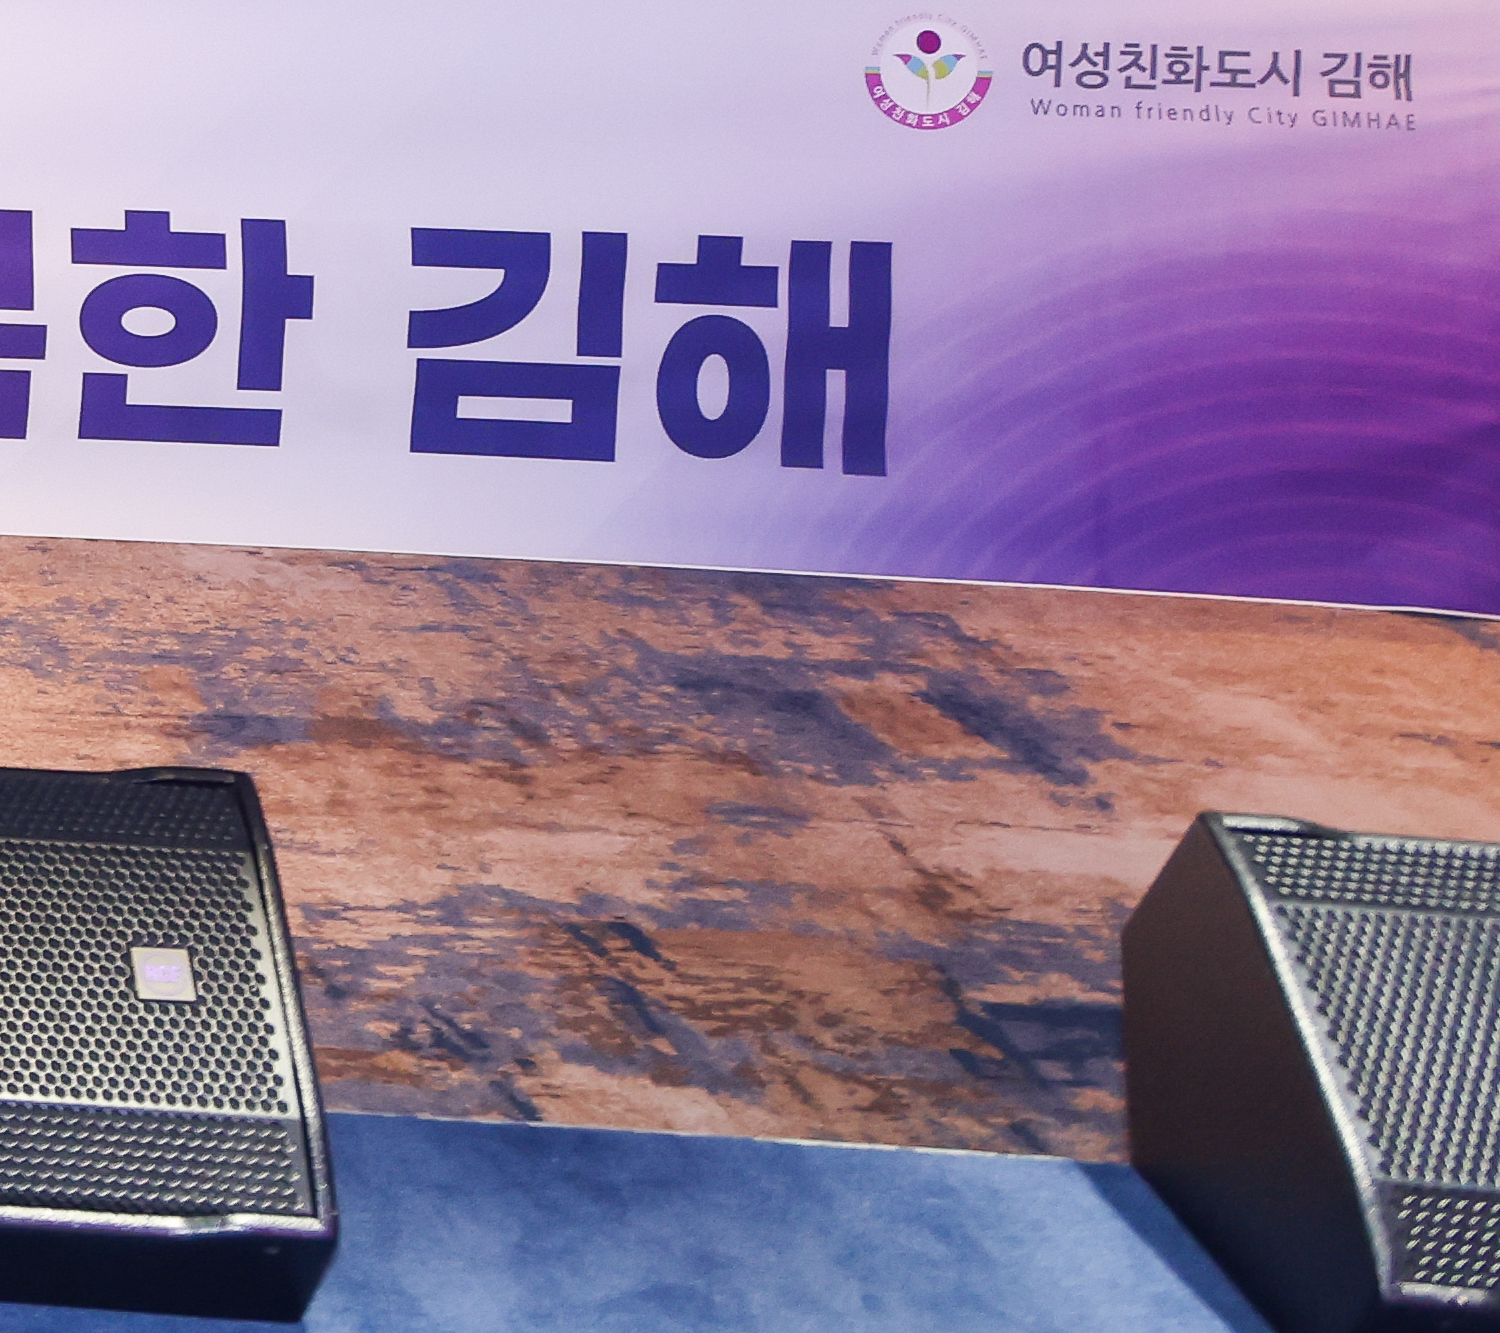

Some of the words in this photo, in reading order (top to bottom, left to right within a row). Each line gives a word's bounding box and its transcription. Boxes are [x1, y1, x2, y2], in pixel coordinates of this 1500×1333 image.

[1021, 41, 1301, 98] 여성친화도시
[1318, 51, 1414, 102] 김해
[873, 85, 950, 127] 여성친화도시
[1030, 98, 1121, 120] Woman
[1134, 100, 1234, 128] friendly
[1248, 106, 1299, 129] City
[1311, 109, 1417, 132] GIMHAE
[407, 229, 894, 476] 김해
